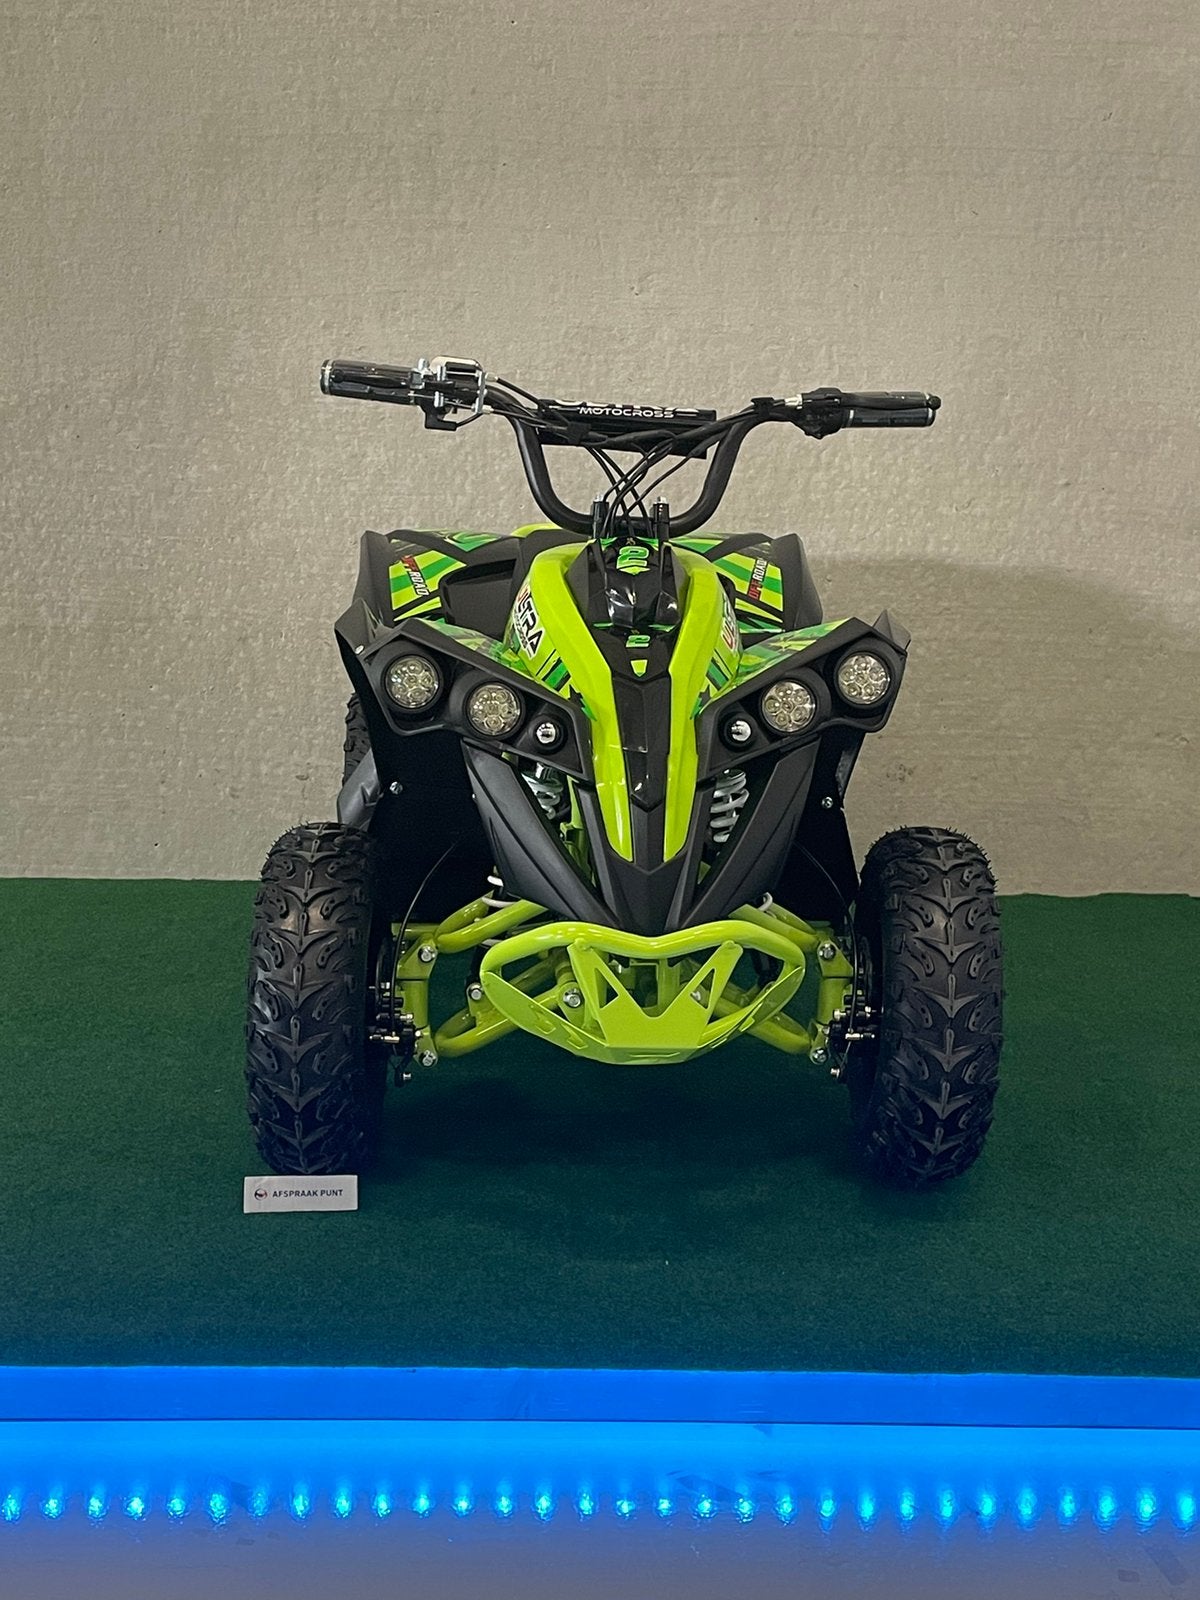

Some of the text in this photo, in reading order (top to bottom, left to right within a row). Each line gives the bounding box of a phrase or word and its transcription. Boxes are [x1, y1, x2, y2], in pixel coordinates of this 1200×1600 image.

[579, 406, 675, 419] MOTOCROSS
[616, 545, 650, 569] 2
[625, 634, 651, 648] 2
[272, 1189, 344, 1198] AFSPRAAK PUNT
